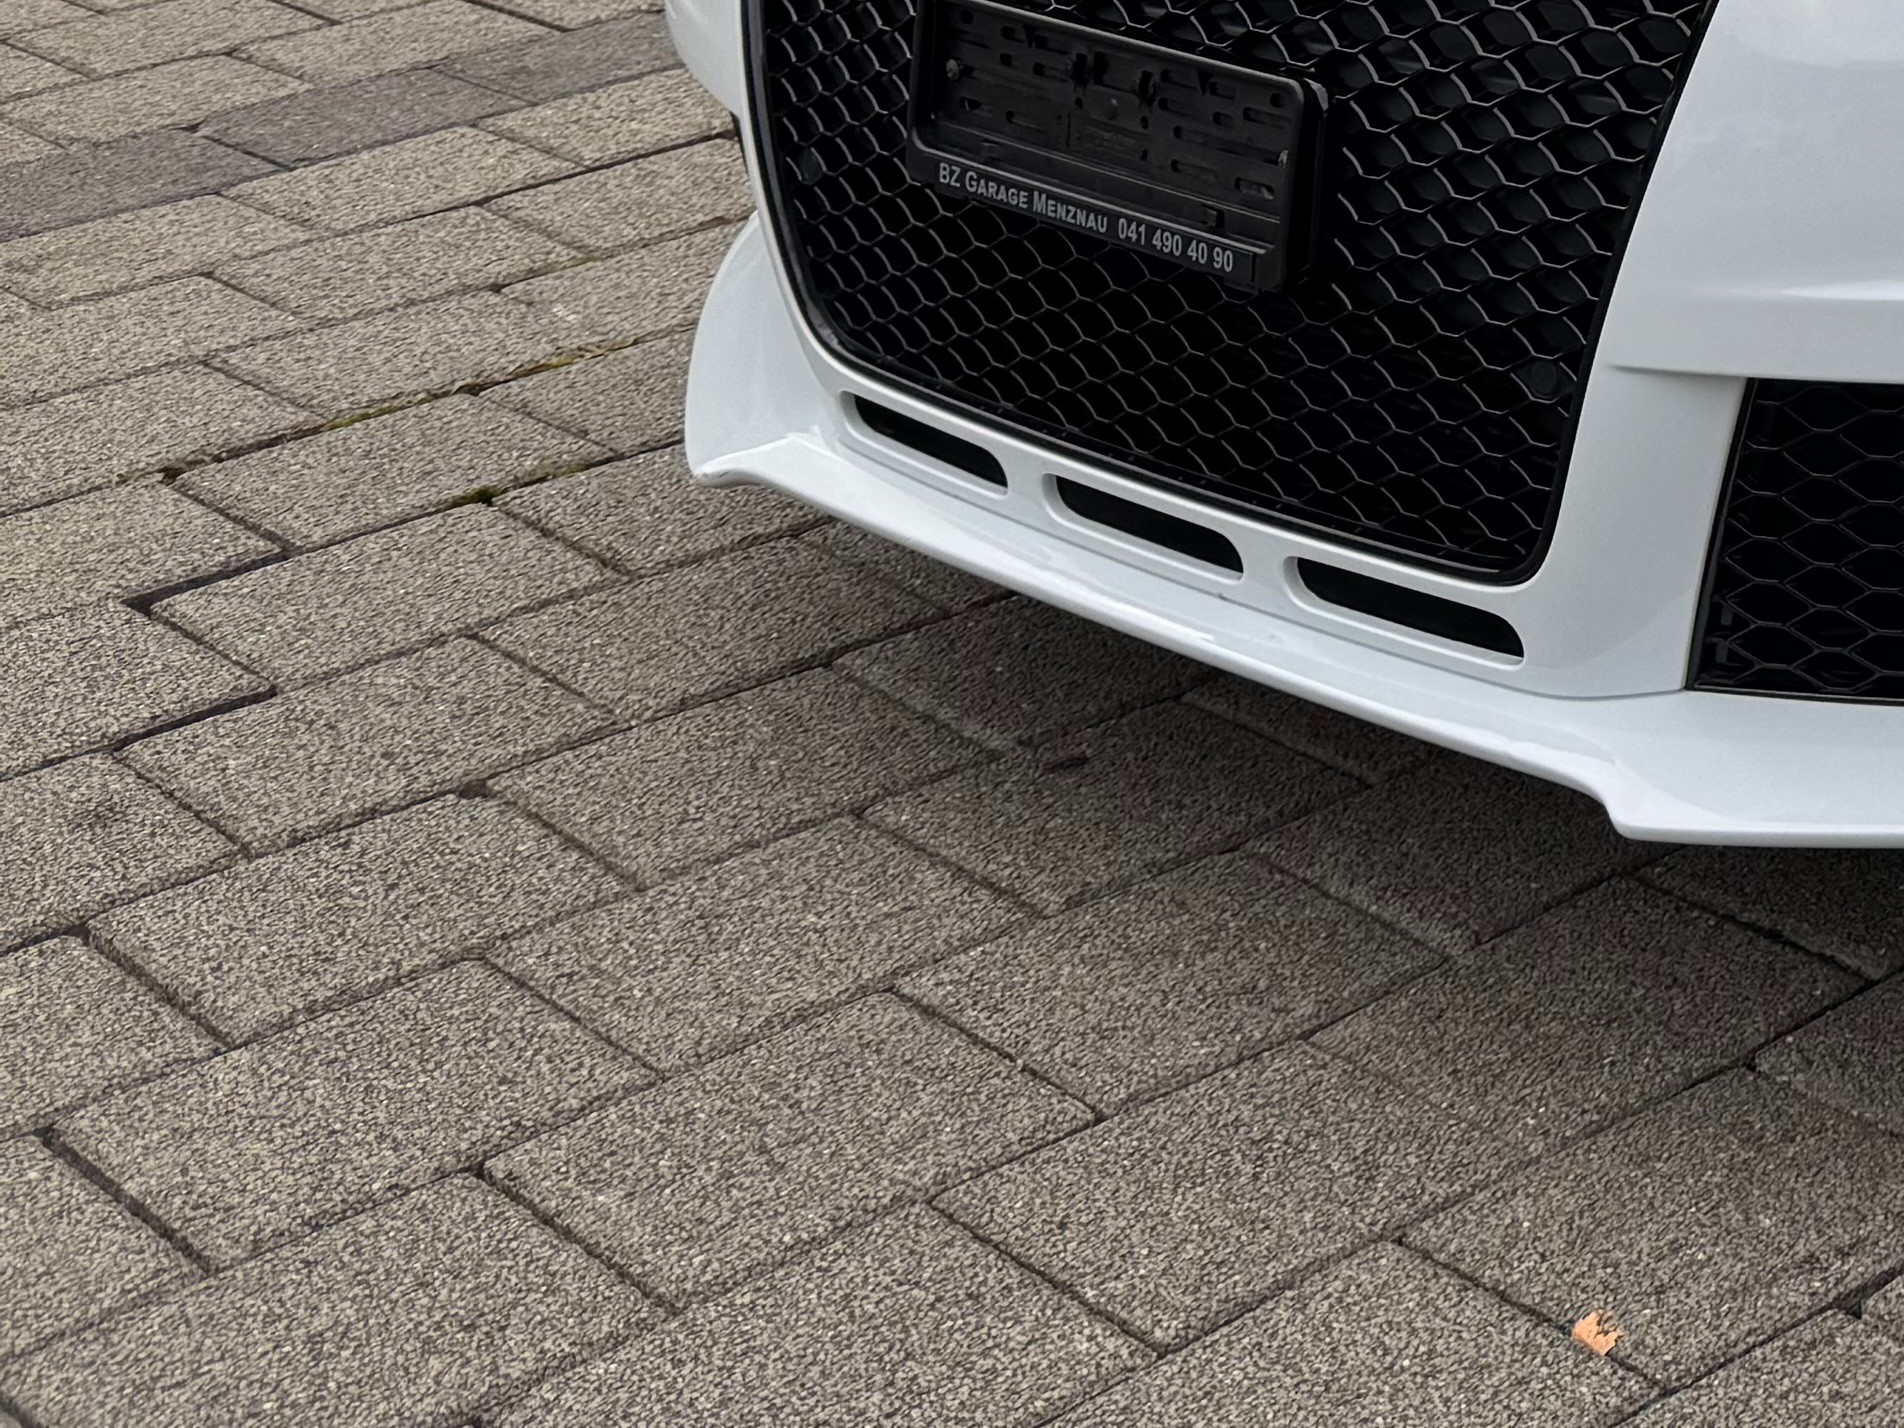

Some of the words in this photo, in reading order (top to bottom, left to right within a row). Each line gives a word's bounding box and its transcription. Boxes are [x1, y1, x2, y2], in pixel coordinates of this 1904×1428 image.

[938, 161, 961, 188] BZ
[965, 170, 1029, 209] GARAGE
[1032, 190, 1108, 233] MENZNAU
[1118, 217, 1146, 246] 041
[1152, 228, 1182, 257] 490
[1187, 242, 1208, 265] 40
[1213, 249, 1234, 273] 90
